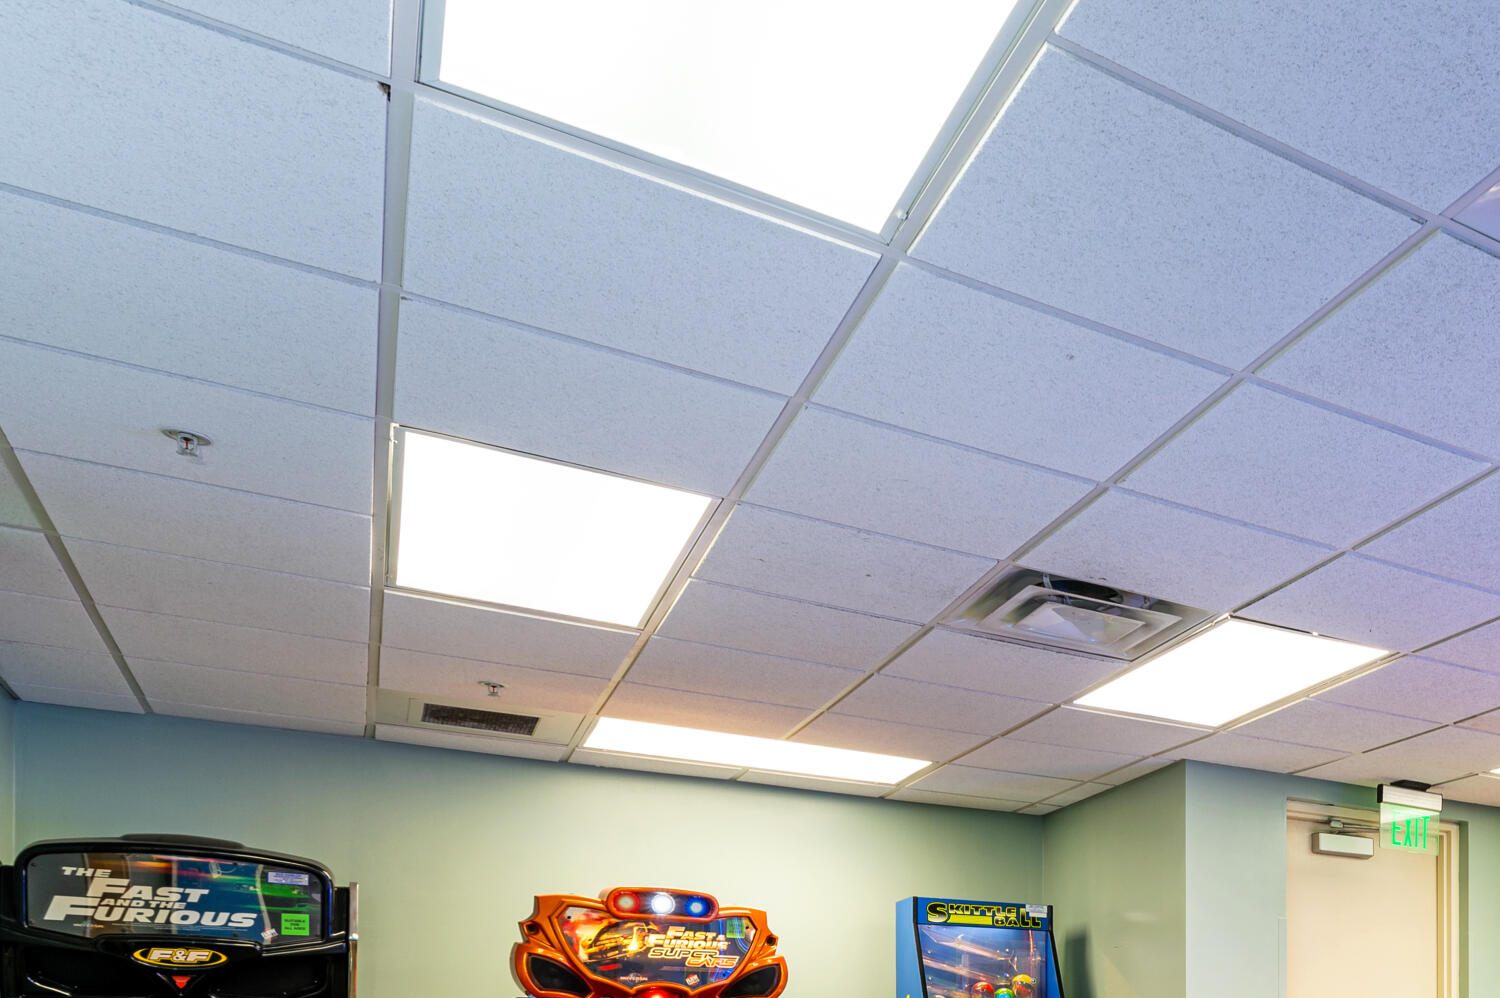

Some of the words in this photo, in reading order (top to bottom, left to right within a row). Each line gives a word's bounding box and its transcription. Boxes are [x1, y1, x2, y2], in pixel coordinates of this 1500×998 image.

[1391, 811, 1430, 850] EXIT
[61, 866, 112, 877] THE
[86, 878, 210, 903] FAST
[43, 895, 258, 928] FURIOUS
[100, 899, 146, 908] AND
[149, 900, 187, 910] THE
[927, 902, 1017, 923] SKITTLE
[666, 926, 716, 941] FAST
[647, 933, 729, 950] FURIOUS
[149, 949, 210, 962] F&F
[648, 947, 720, 959] SUPER
[685, 954, 740, 969] CARS
